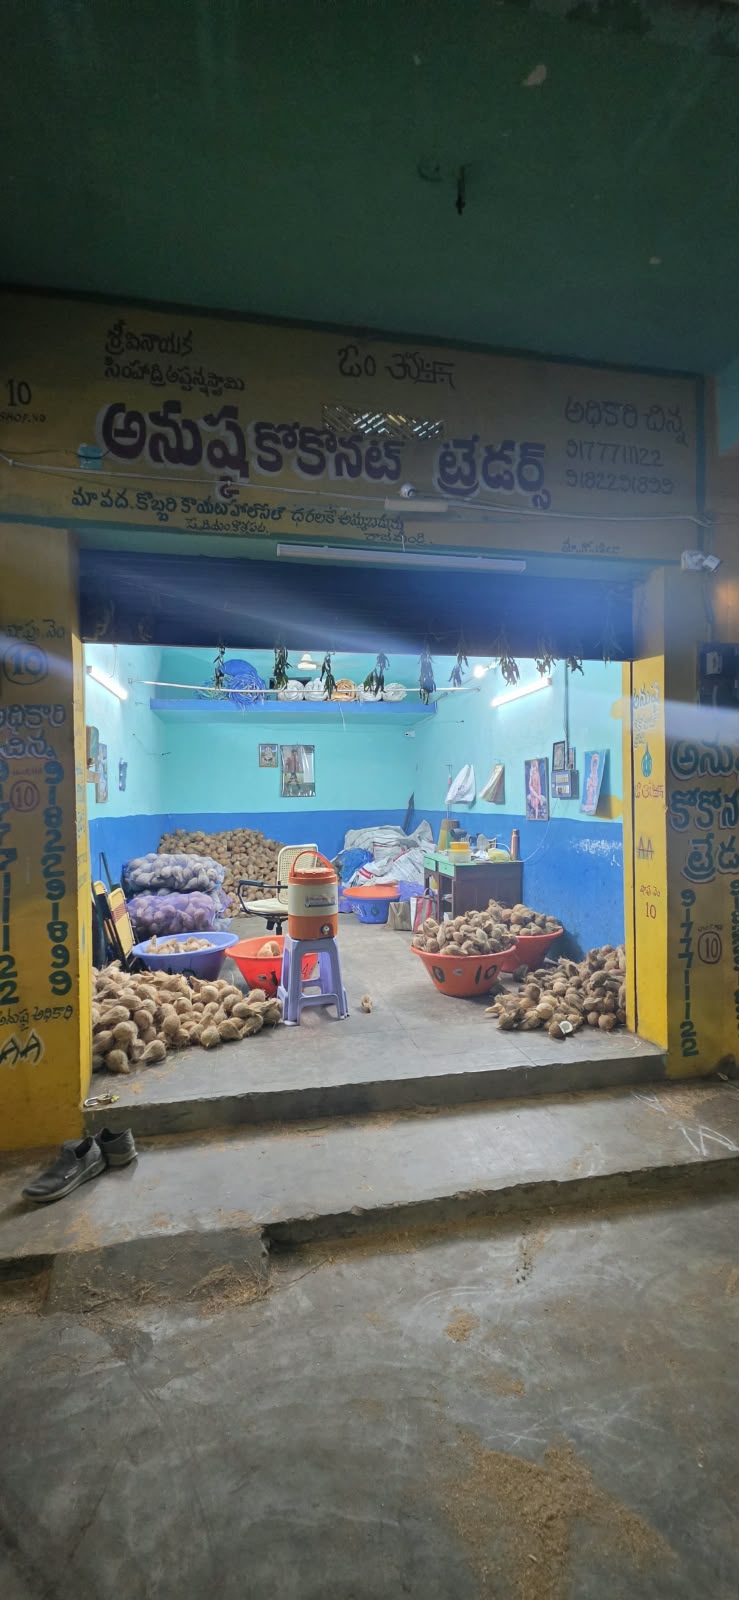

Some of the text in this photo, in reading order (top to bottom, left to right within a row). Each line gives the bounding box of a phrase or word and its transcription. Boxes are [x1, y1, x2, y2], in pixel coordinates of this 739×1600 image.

[7, 377, 32, 407] 10
[565, 396, 688, 448] అధికారి చిన్న
[101, 400, 553, 511] అనుష్క కోకోనట్ ట్రేడర్స్
[566, 439, 664, 468] 9177711122
[136, 491, 178, 522] కొబ్బరి
[11, 650, 43, 676] 10
[15, 785, 34, 809] 10
[42, 760, 72, 996] 9182291899
[646, 902, 657, 919] 10
[705, 937, 718, 959] 10
[678, 888, 700, 1057] 9177711122
